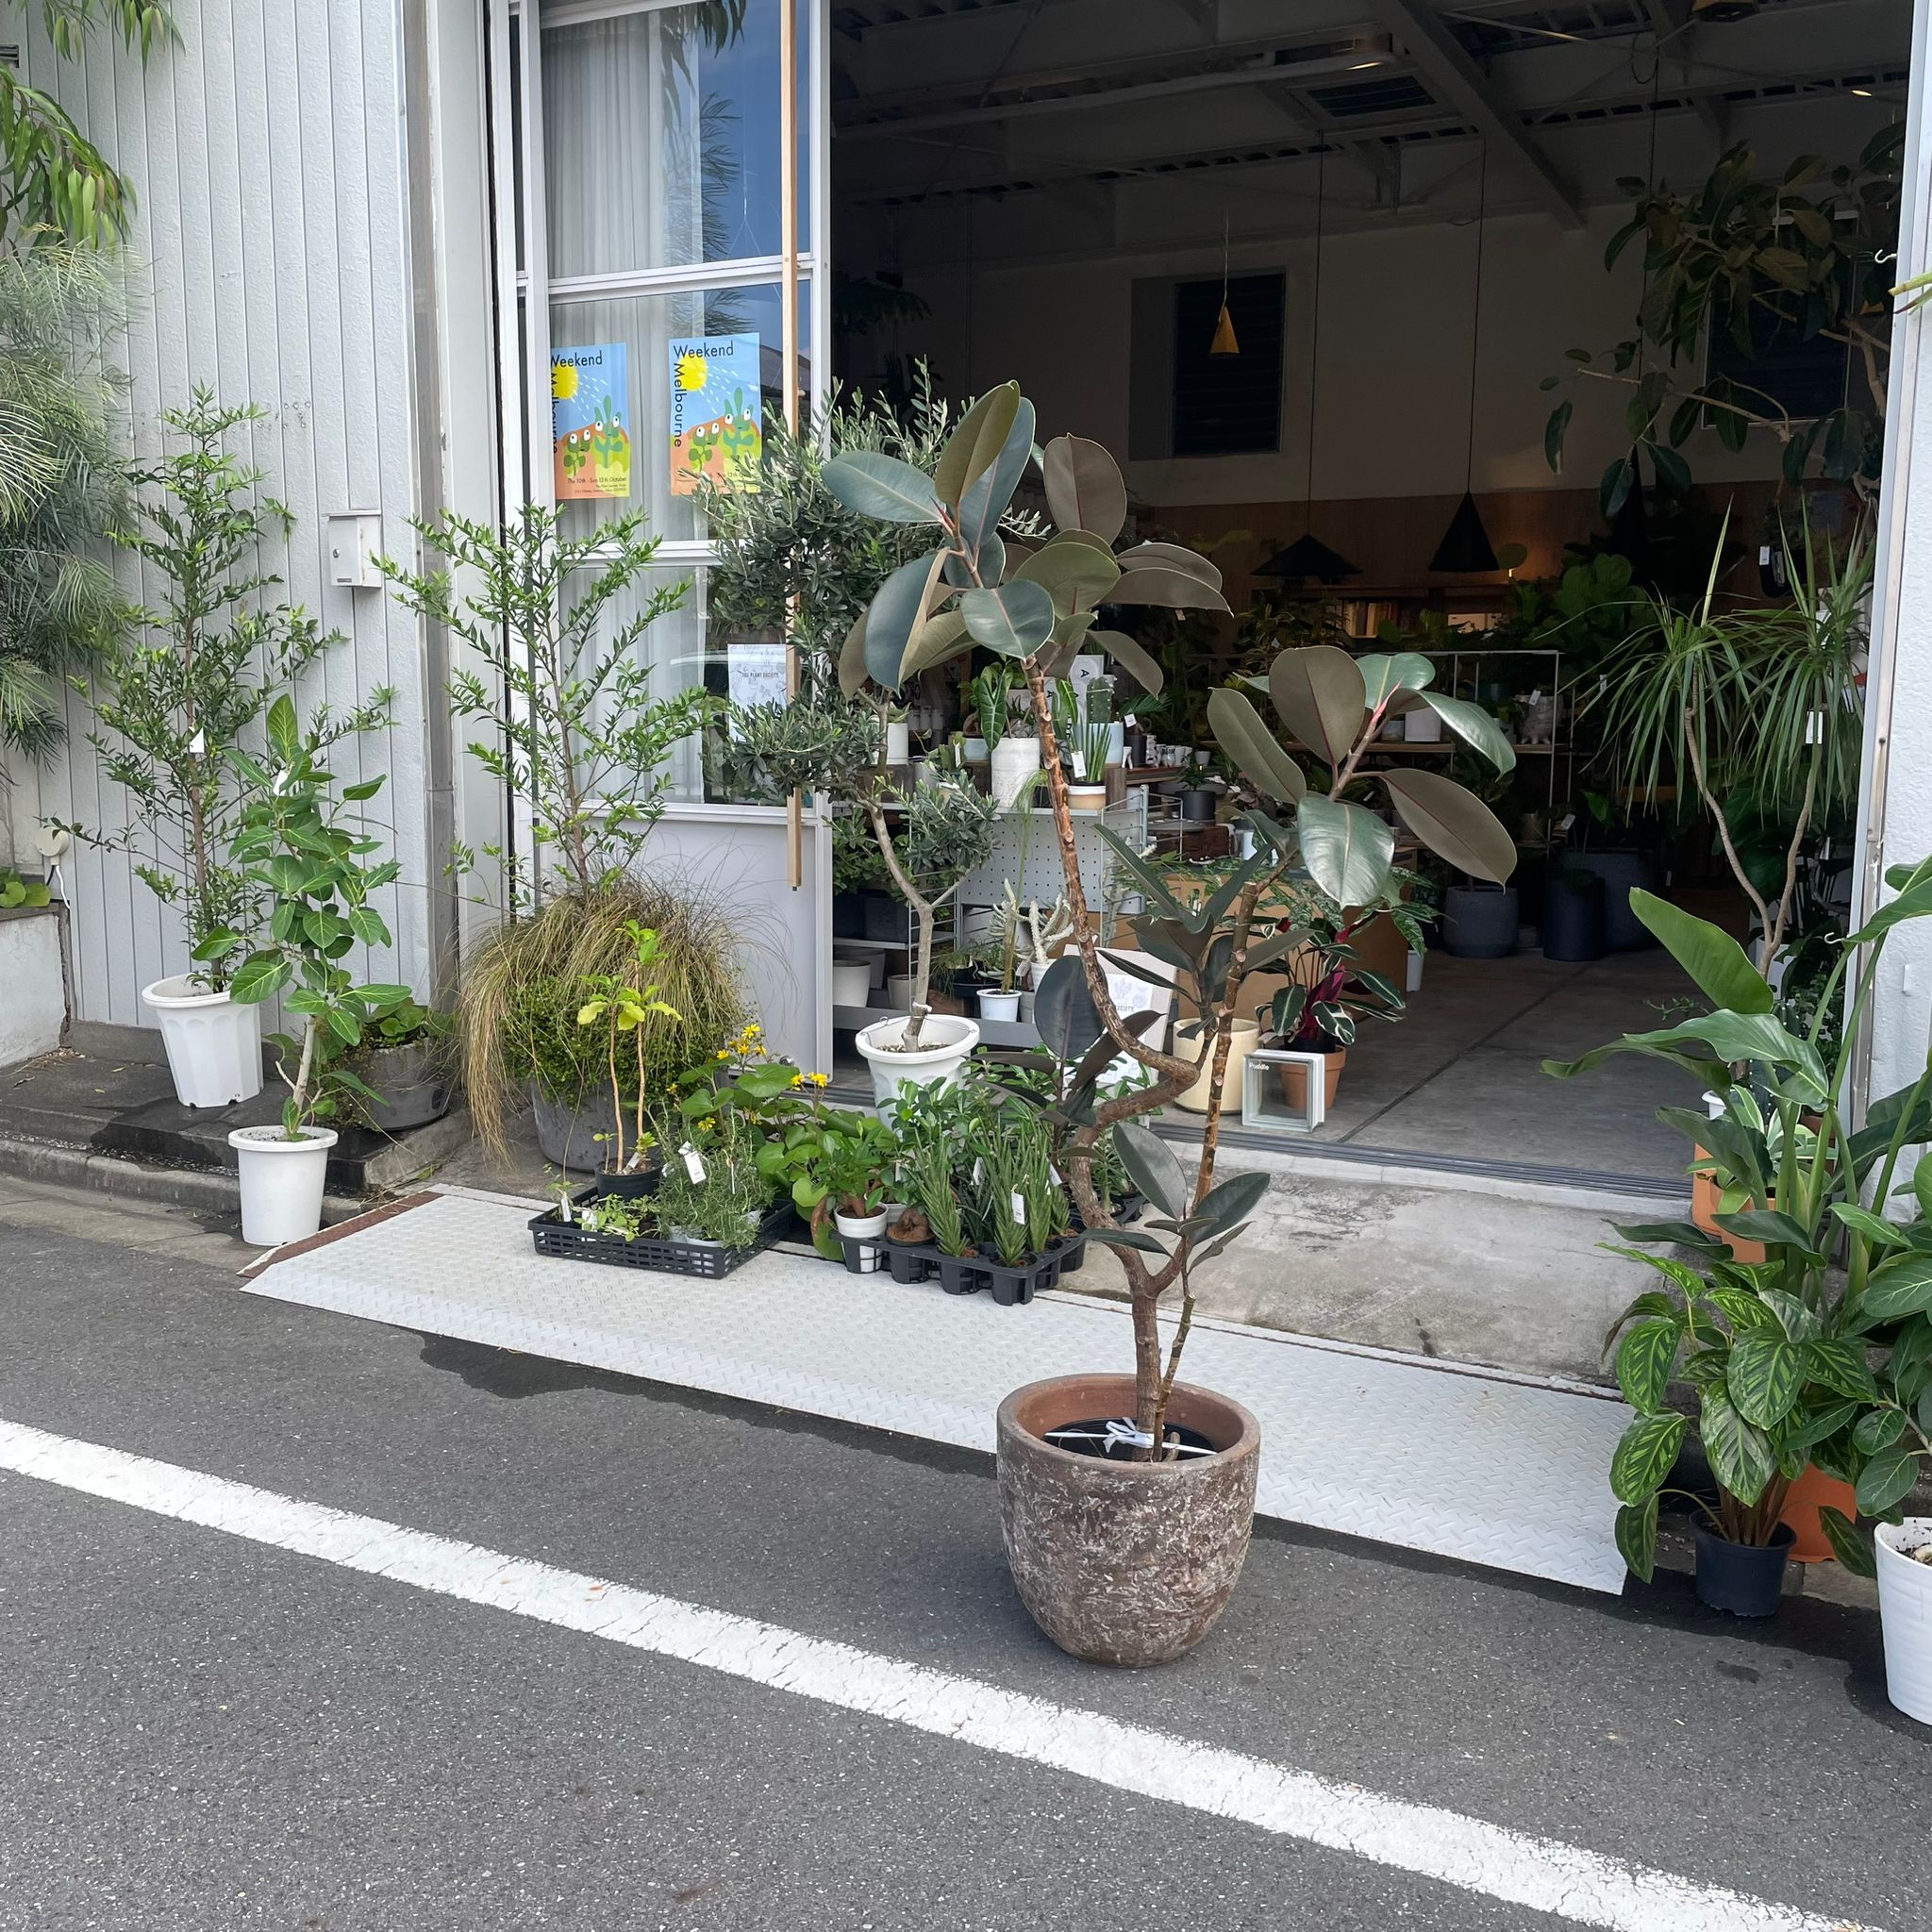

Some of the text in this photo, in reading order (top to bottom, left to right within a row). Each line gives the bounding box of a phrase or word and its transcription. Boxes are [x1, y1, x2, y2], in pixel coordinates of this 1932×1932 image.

[673, 340, 734, 358] Weekend
[551, 350, 603, 368] Weekend
[674, 362, 687, 447] Melbourne
